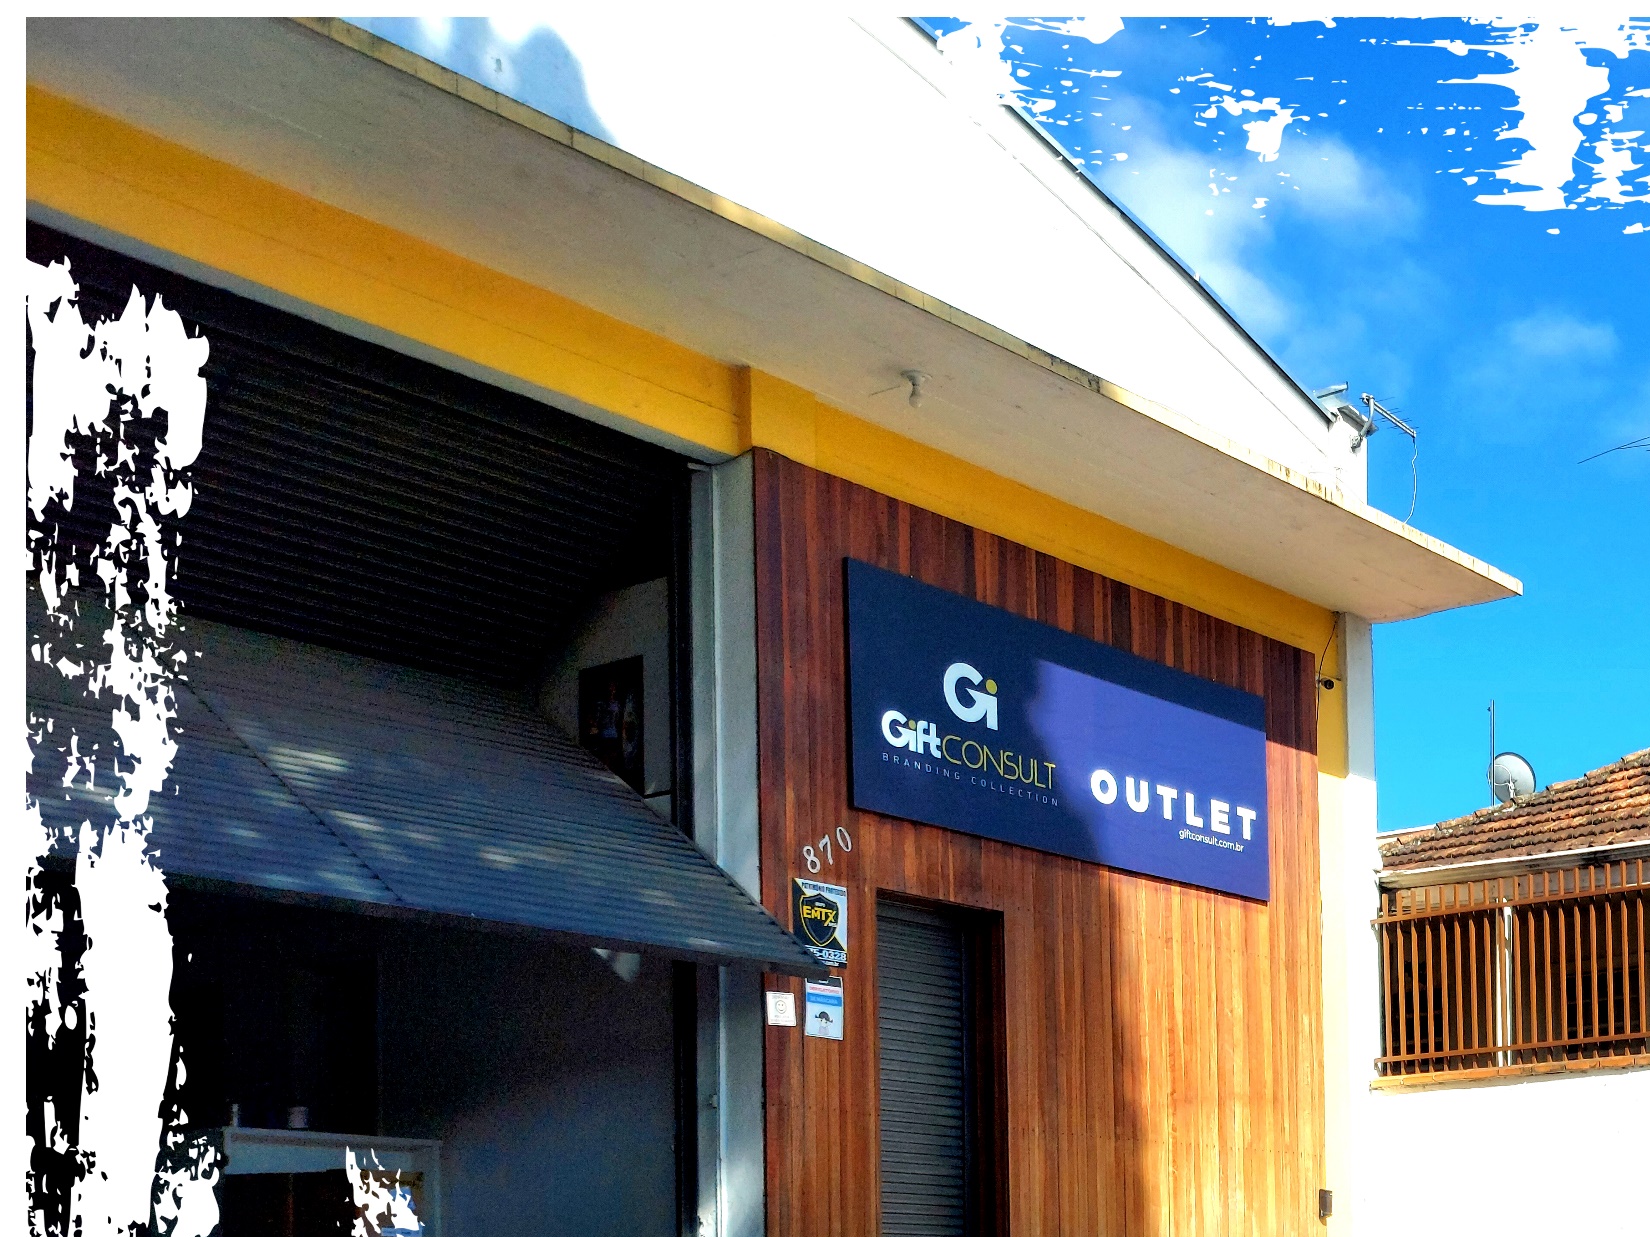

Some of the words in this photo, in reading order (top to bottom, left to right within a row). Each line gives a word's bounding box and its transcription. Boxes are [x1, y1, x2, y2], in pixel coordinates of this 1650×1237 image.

[882, 752, 961, 780] BRANDING
[971, 776, 1059, 807] COLLECTION
[1090, 769, 1257, 841] OUTLET
[803, 826, 853, 875] 870
[1178, 828, 1245, 853] giftconsult.com.br
